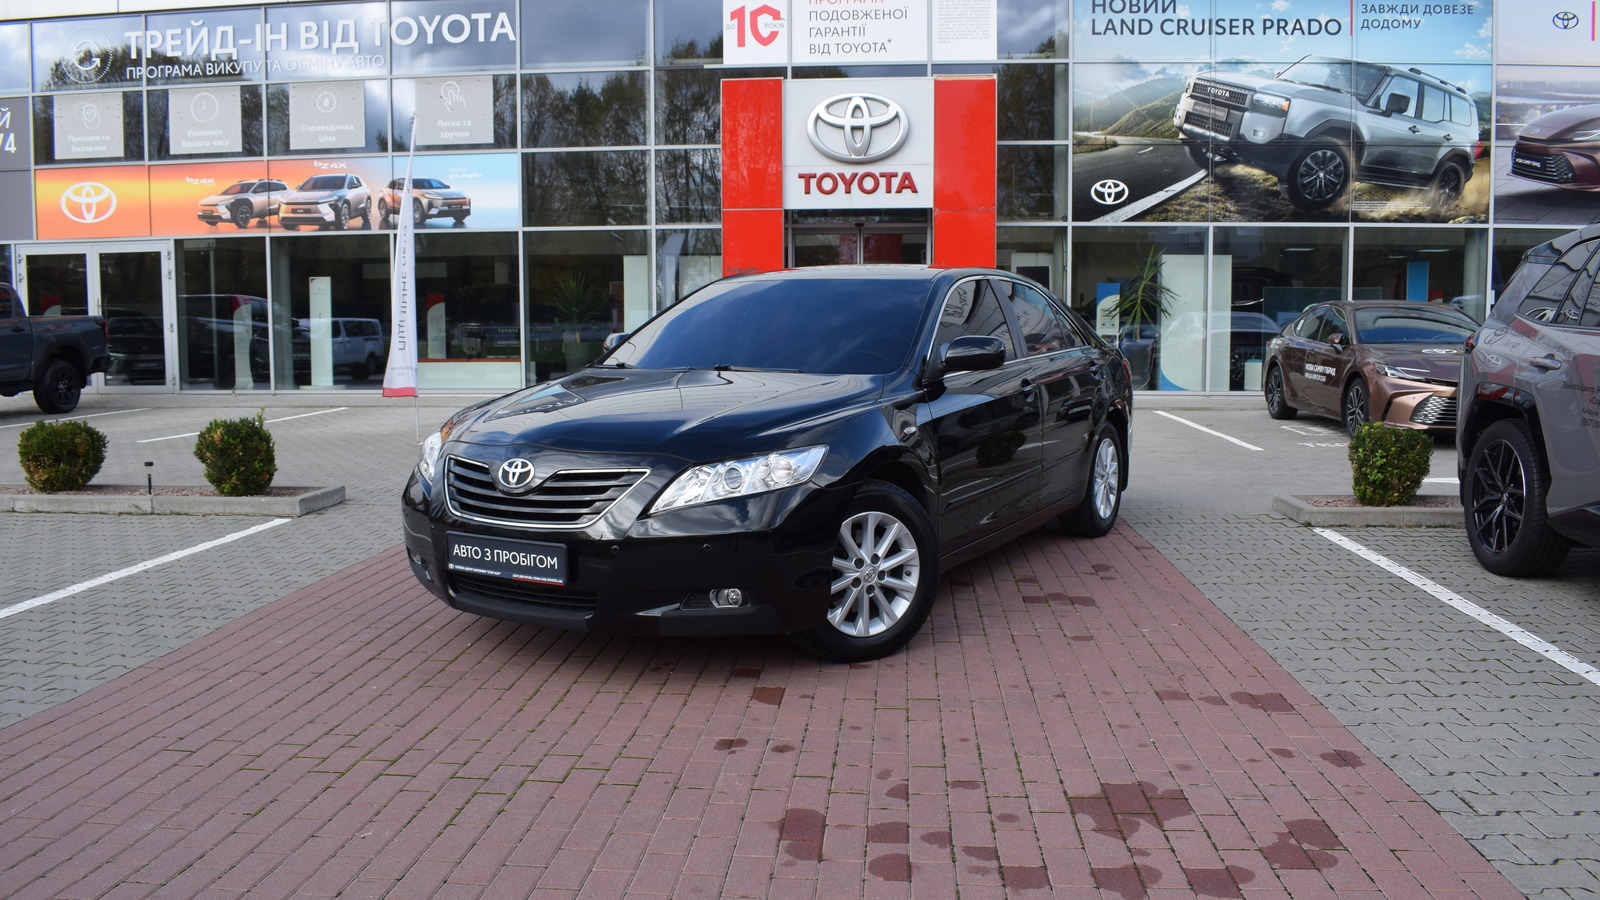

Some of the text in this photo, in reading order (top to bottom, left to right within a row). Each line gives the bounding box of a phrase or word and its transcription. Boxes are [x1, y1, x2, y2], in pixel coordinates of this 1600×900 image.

[809, 6, 909, 22] ПОДОВЖЕНОЇ
[1361, 4, 1474, 15] ЗАВЖДИ ДОВЕЗЕ
[809, 24, 866, 38] ГАРАНТІЇ
[1091, 18, 1342, 36] LAND CRUISER PRADO
[1361, 19, 1422, 30] ДОДОМУ
[124, 12, 516, 61] ТРЕЙД-ІН ВІД TOYOTA
[809, 43, 831, 56] ВІД
[126, 54, 385, 80] ПРОГРАМА ВИКУПУ ТА ОБМІНУ АВТО
[798, 172, 918, 195] TOYOTA
[453, 544, 482, 560] АВТО
[494, 549, 558, 570] ПРОБІГОМ
